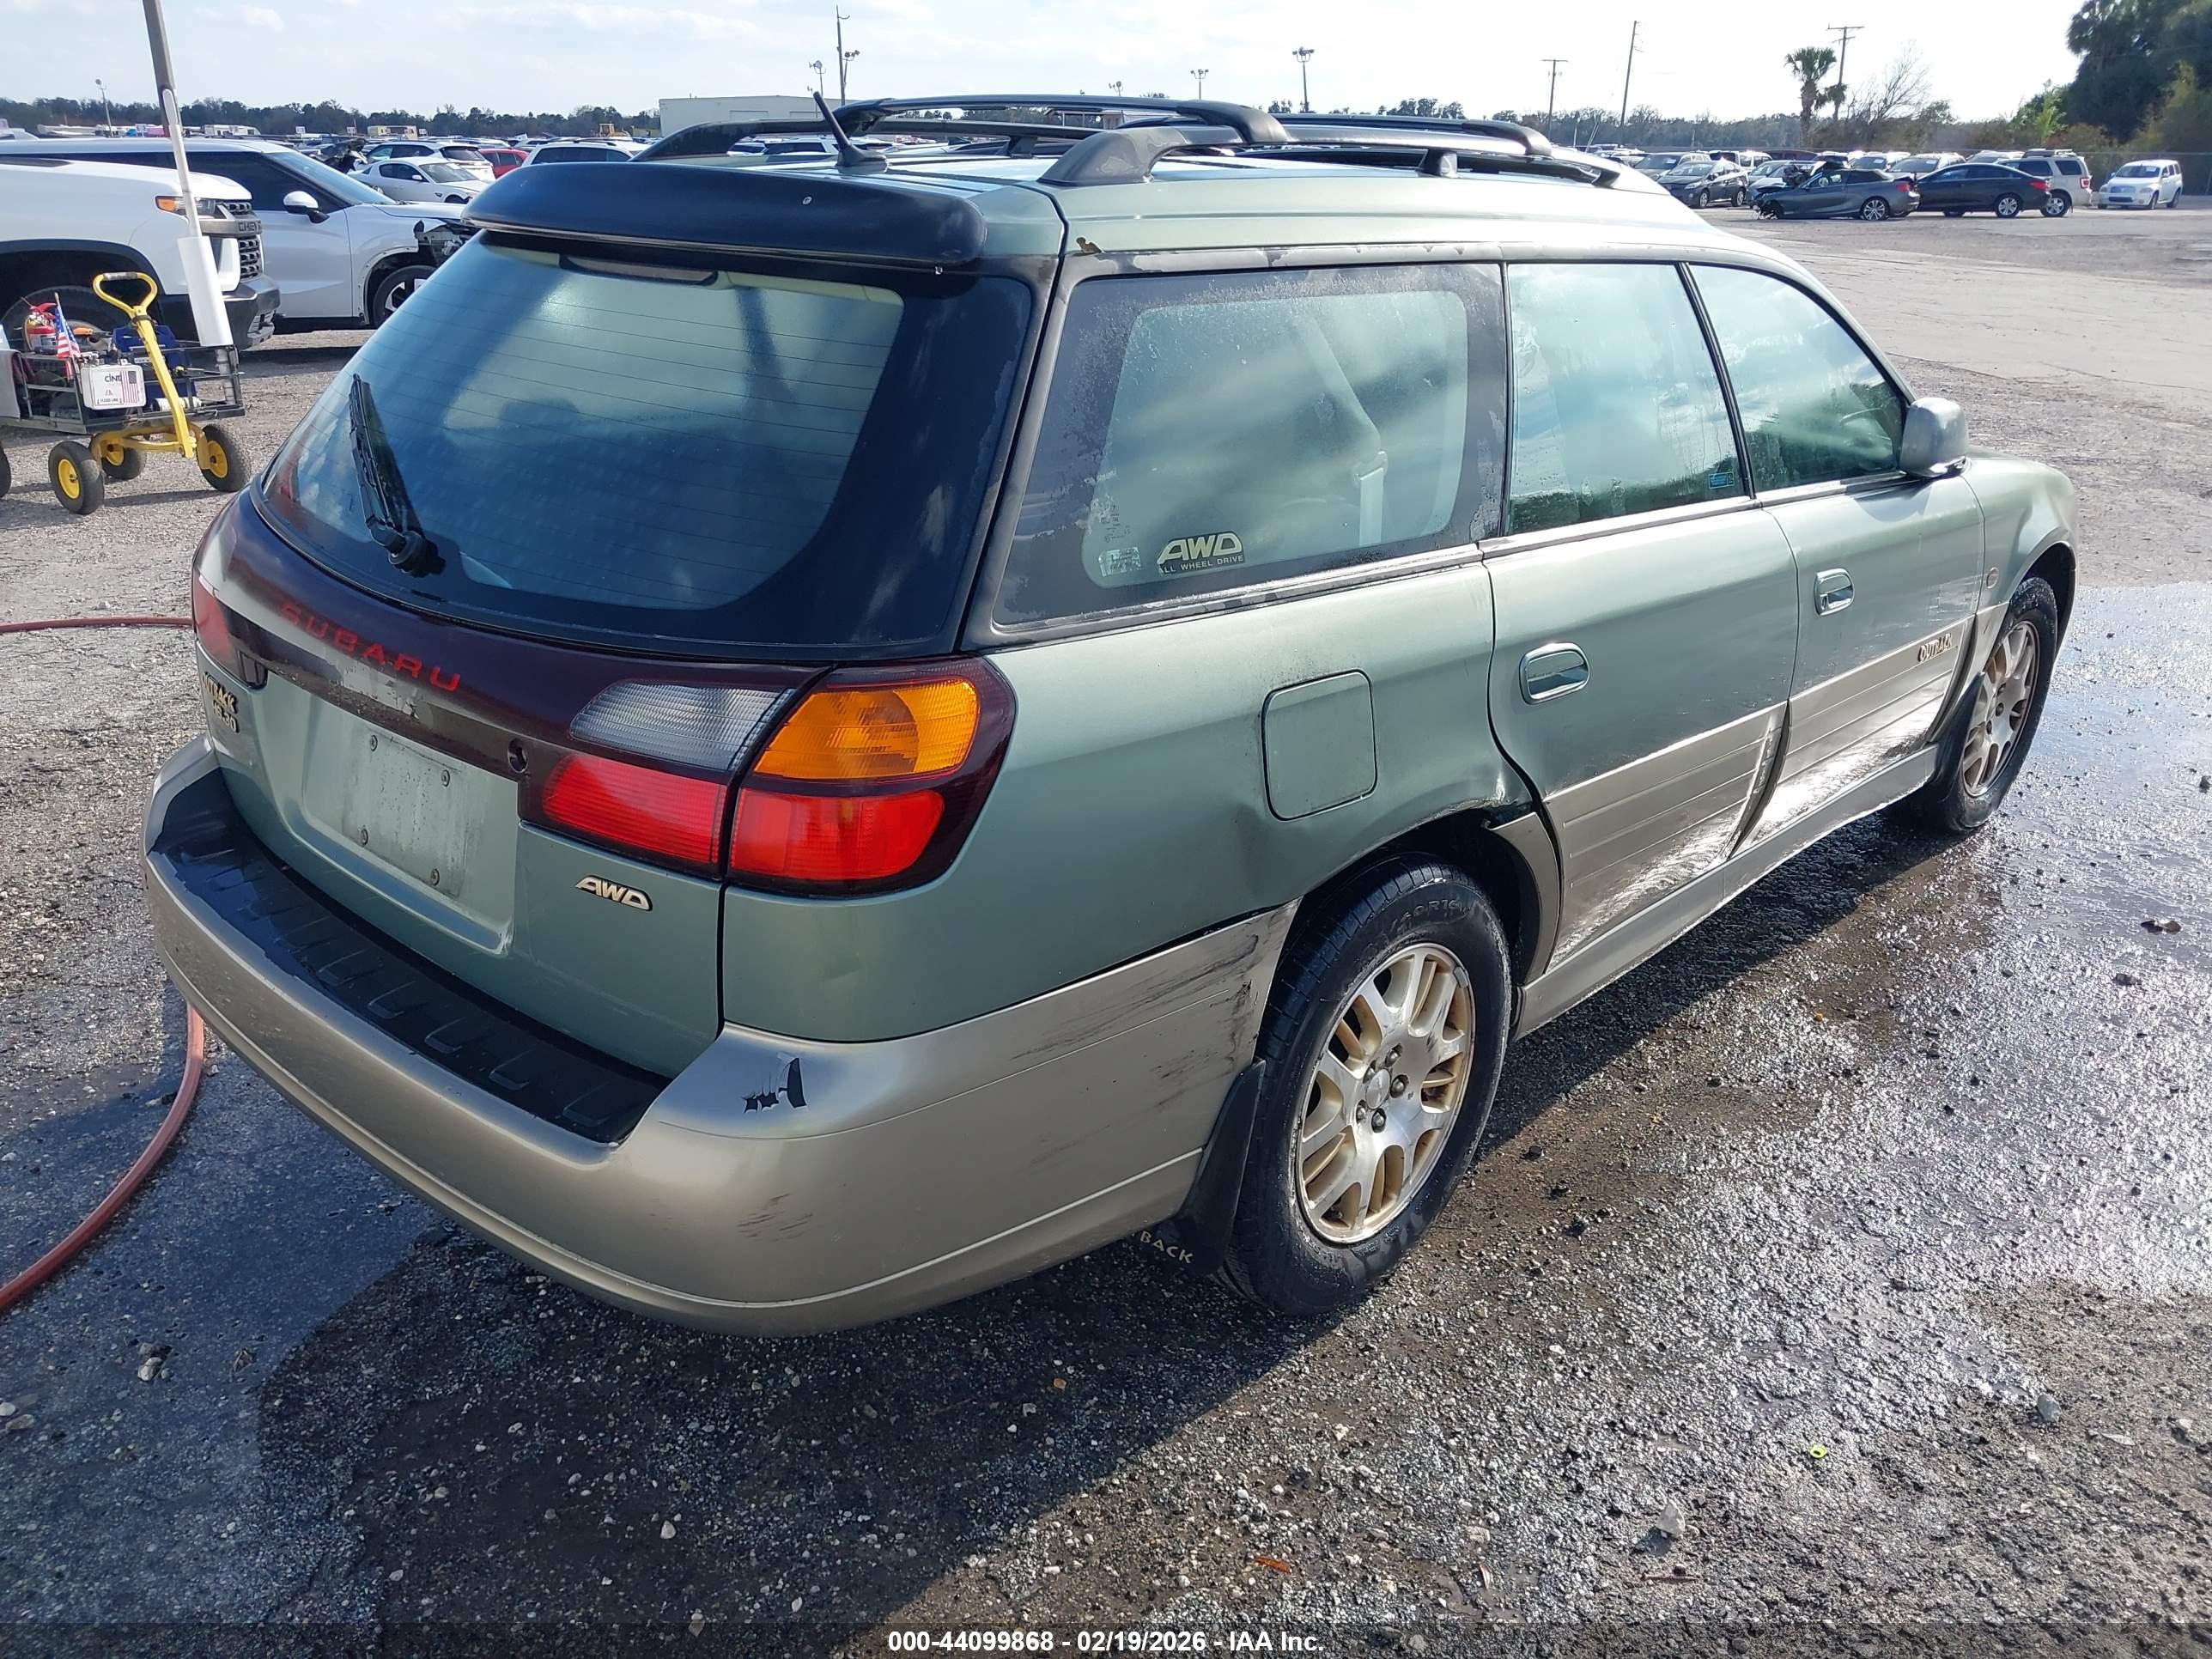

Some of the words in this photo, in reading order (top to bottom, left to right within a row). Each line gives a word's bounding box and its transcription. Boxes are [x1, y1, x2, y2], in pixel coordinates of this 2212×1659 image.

[1157, 532, 1243, 564] AWD
[1180, 559, 1213, 571] WHEEL
[1216, 554, 1244, 565] DRIVE
[279, 602, 461, 692] SUBARU
[574, 875, 653, 911] AWD
[1139, 1230, 1194, 1264] BACK
